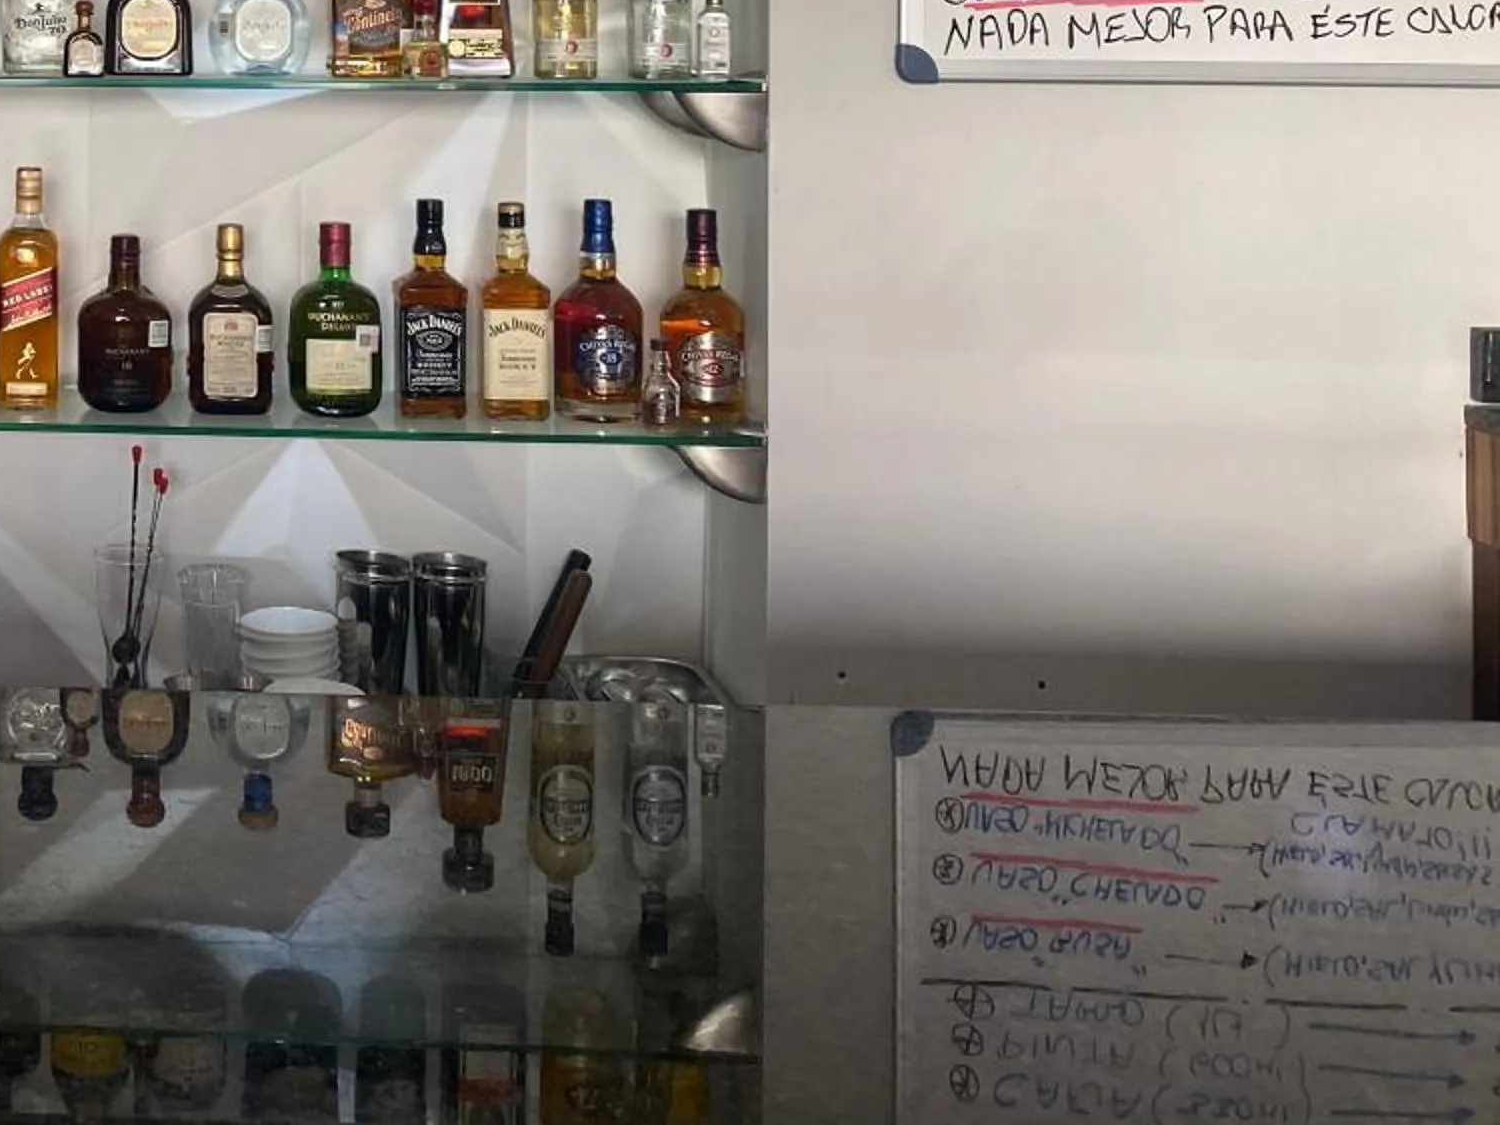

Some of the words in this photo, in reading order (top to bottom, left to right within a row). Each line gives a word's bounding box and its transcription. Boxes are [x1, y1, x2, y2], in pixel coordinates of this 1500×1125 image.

[944, 14, 1049, 56] NADA
[1067, 11, 1191, 50] MEJOR
[1203, 4, 1293, 43] PARA
